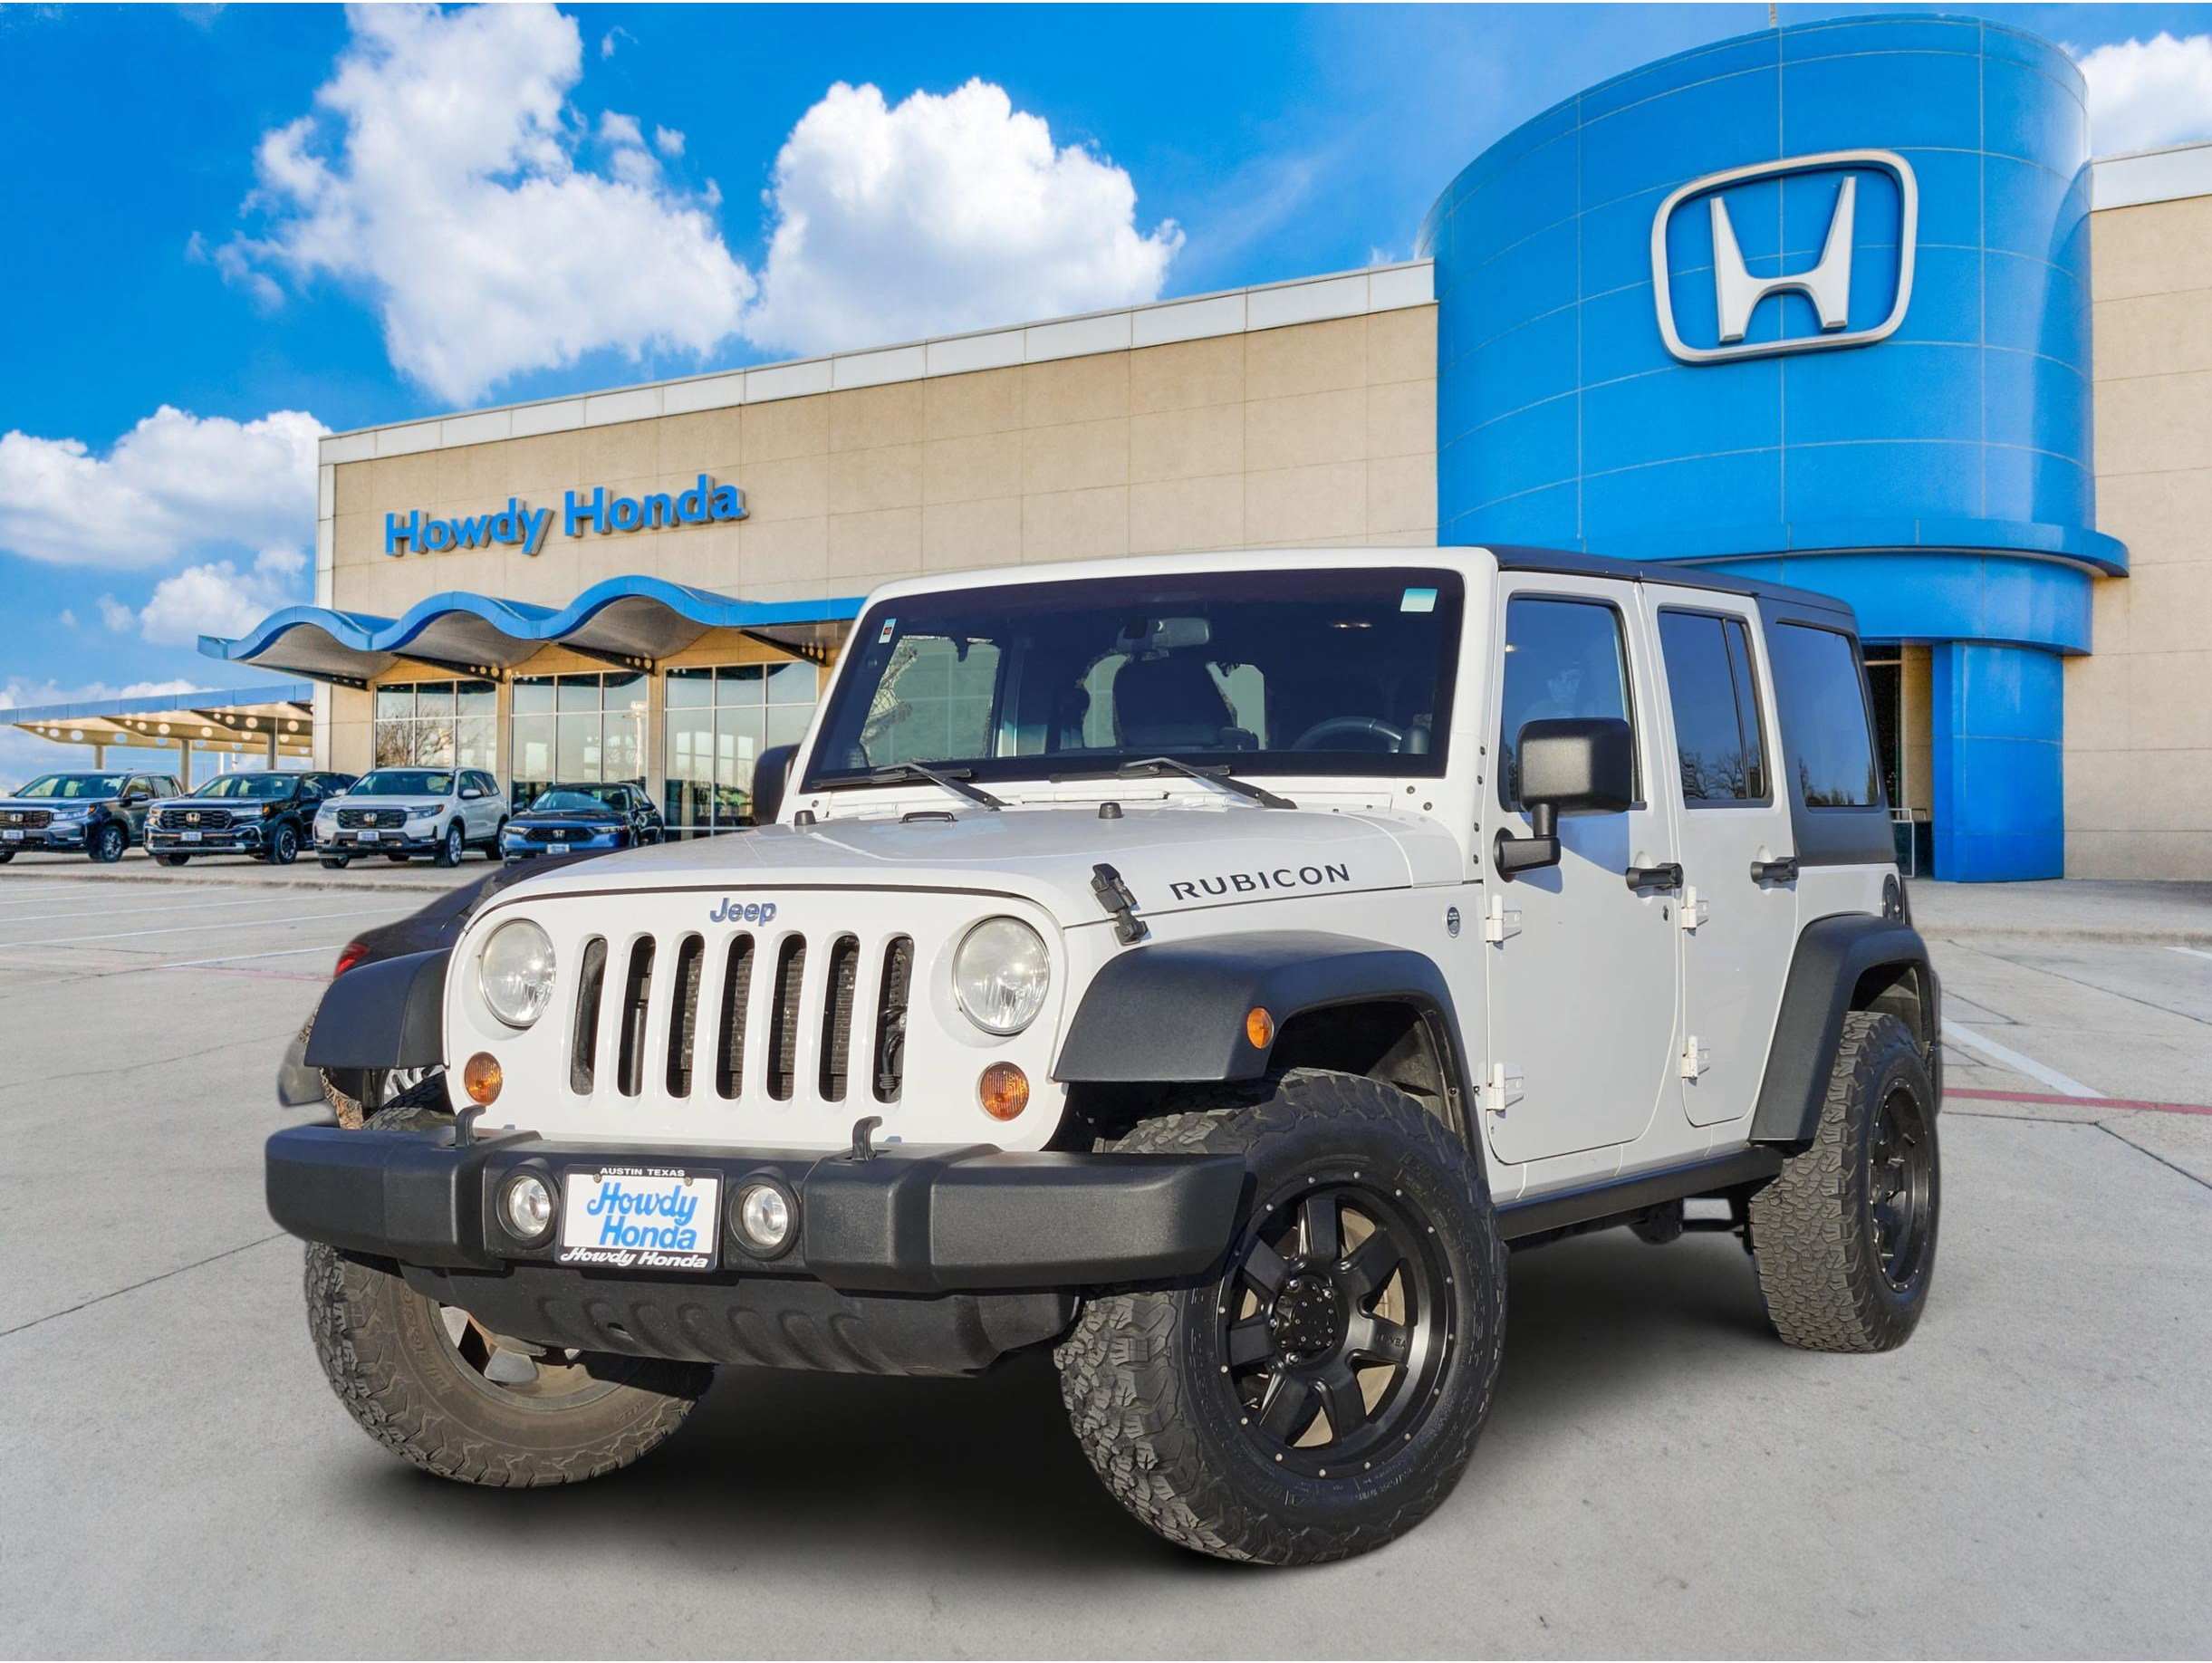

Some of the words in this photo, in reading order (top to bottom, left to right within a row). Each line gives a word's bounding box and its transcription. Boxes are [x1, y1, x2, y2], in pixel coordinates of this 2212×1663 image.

[384, 496, 553, 557] Howdy
[564, 474, 748, 539] Honda
[1169, 863, 1351, 901] RUBICON
[709, 898, 777, 927] Jeep
[600, 1168, 642, 1177] AUSTIN
[647, 1168, 686, 1178] TEXAS
[586, 1182, 698, 1226] Howdy
[599, 1215, 697, 1250] Honda
[560, 1246, 637, 1266] Howdy
[638, 1251, 708, 1268] Honda
